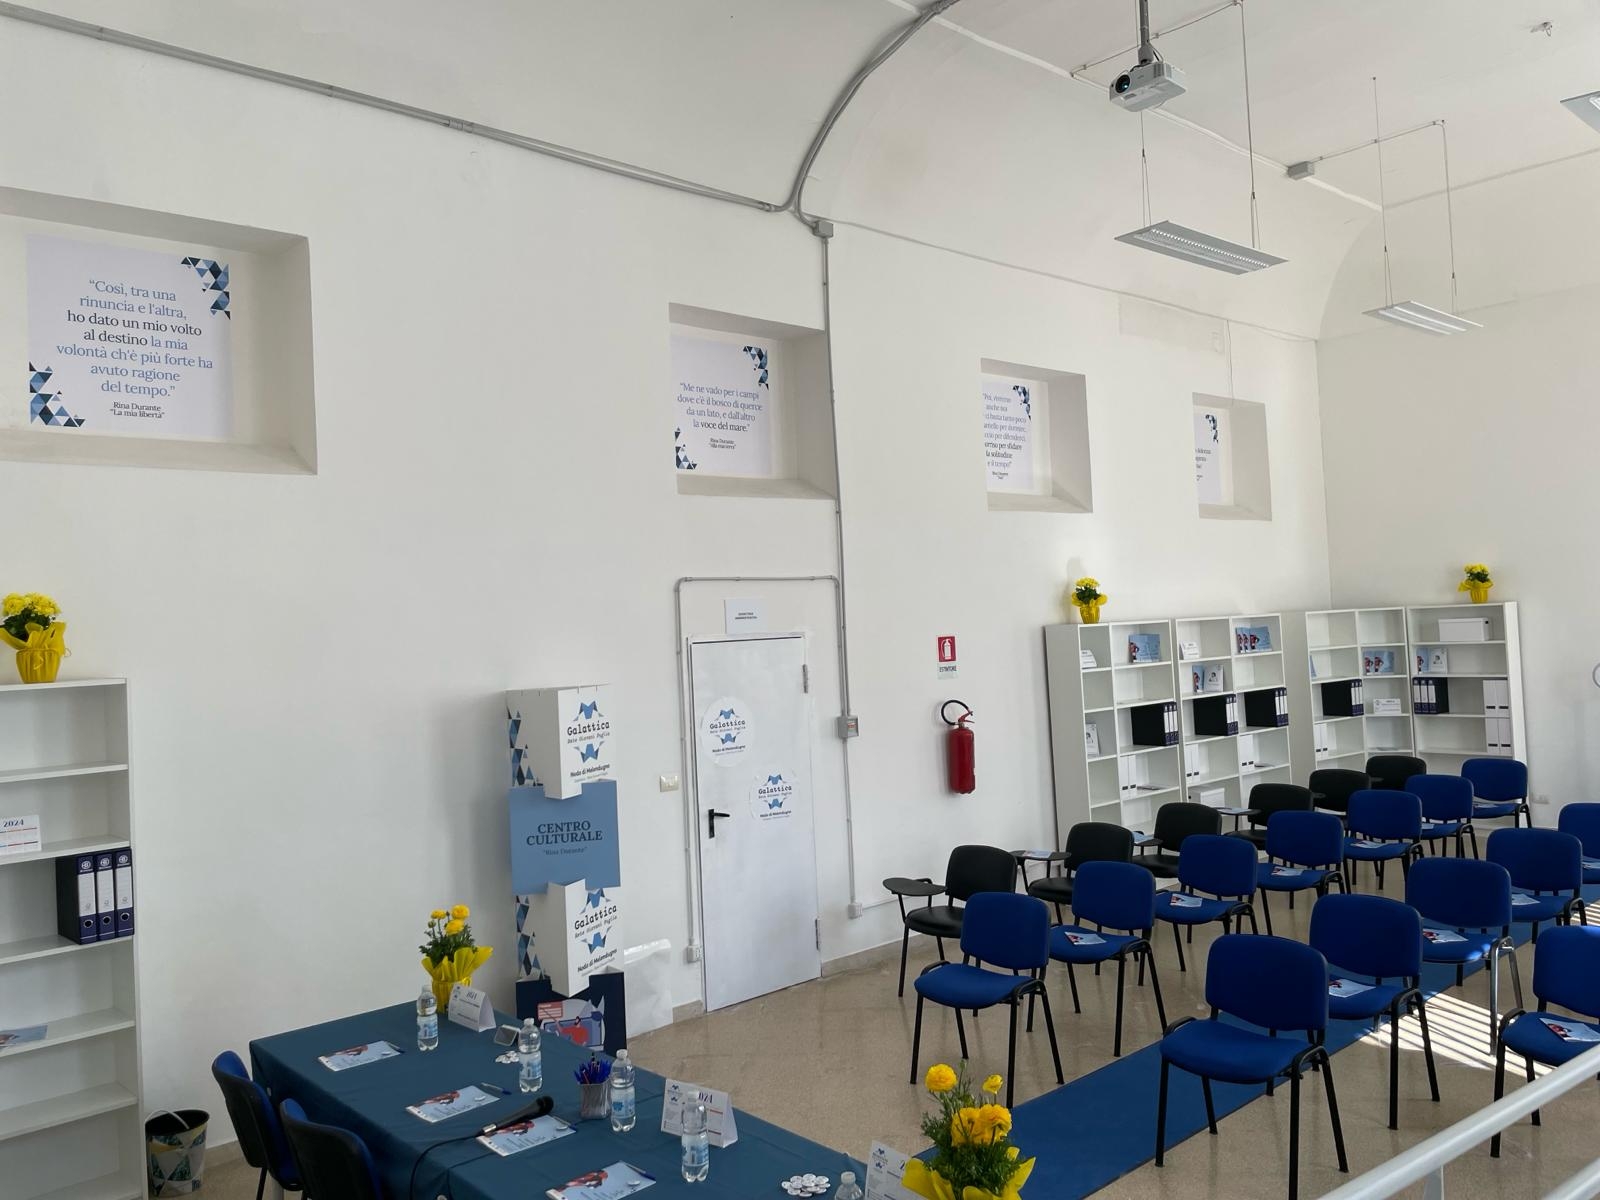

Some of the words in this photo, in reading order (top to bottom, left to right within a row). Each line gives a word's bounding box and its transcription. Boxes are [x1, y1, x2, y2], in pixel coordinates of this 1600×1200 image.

[131, 285, 149, 298] tra
[152, 289, 176, 302] una
[80, 296, 134, 313] rinuncia
[138, 304, 146, 314] e
[149, 302, 187, 320] l'altra,
[67, 310, 86, 324] ho
[88, 312, 118, 327] dato
[122, 318, 139, 329] un
[142, 319, 168, 332] mio
[170, 321, 202, 336] volto
[84, 329, 94, 341] al
[98, 330, 148, 346] destino
[151, 336, 162, 348] la
[165, 338, 188, 350] mia
[56, 344, 107, 359] volontà
[110, 349, 138, 362] ch'è
[141, 352, 162, 366] più
[164, 352, 196, 367] forte
[198, 356, 213, 369] ha
[90, 364, 128, 376] avuto
[132, 369, 181, 382] ragione
[101, 380, 121, 392] del
[124, 383, 176, 399] tempo."
[680, 382, 694, 392] "Me
[706, 386, 722, 394] vado
[724, 389, 735, 398] per
[740, 392, 759, 401] campi
[113, 401, 130, 410] Rina
[131, 402, 162, 412] Durante
[677, 394, 694, 404] dove
[712, 398, 732, 408] bosco
[732, 400, 739, 408] di
[686, 407, 695, 415] da
[693, 419, 700, 428] la
[567, 720, 610, 736] Galattica
[710, 720, 745, 730] Galattica
[758, 786, 792, 795] Galattica
[3, 819, 24, 828] 2024
[537, 820, 591, 834] CENTRO
[526, 830, 603, 846] CULTURALE
[574, 904, 617, 930] Galattica
[699, 1092, 713, 1104] 024
